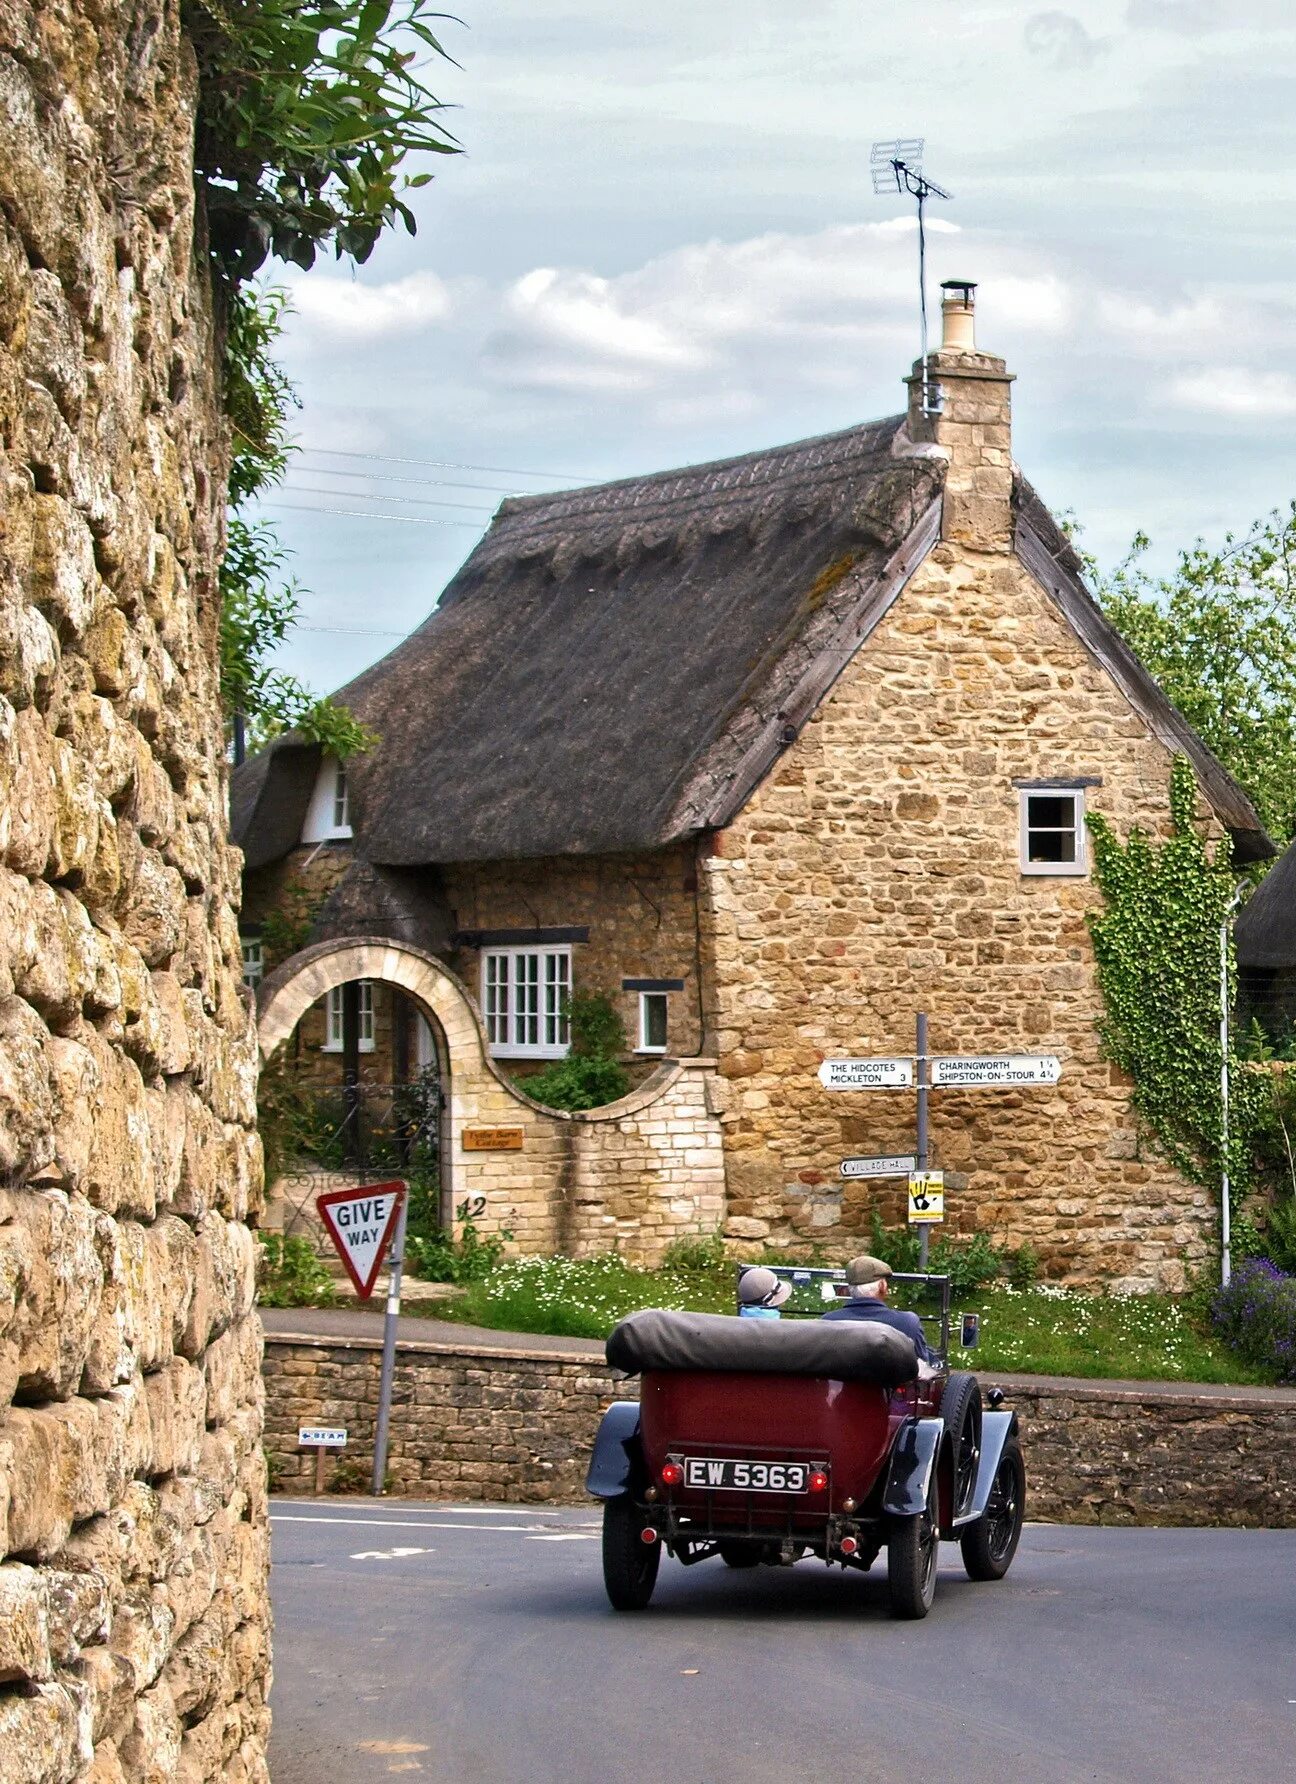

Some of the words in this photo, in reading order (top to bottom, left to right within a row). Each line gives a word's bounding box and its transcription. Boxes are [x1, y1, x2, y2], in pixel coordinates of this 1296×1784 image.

[831, 1064, 847, 1072] THE
[851, 1063, 896, 1072] HIDCOTES
[939, 1061, 1010, 1070] CHARINGWORTH
[830, 1074, 881, 1083] MICKLETON
[900, 1073, 906, 1082] 3
[939, 1071, 1035, 1080] SHIPSTON-ON-STOUR
[851, 1161, 887, 1171] VILLAGE
[337, 1199, 385, 1226] GIVE
[347, 1228, 379, 1246] WAY
[690, 1462, 724, 1485] EW
[733, 1464, 803, 1489] 5363
